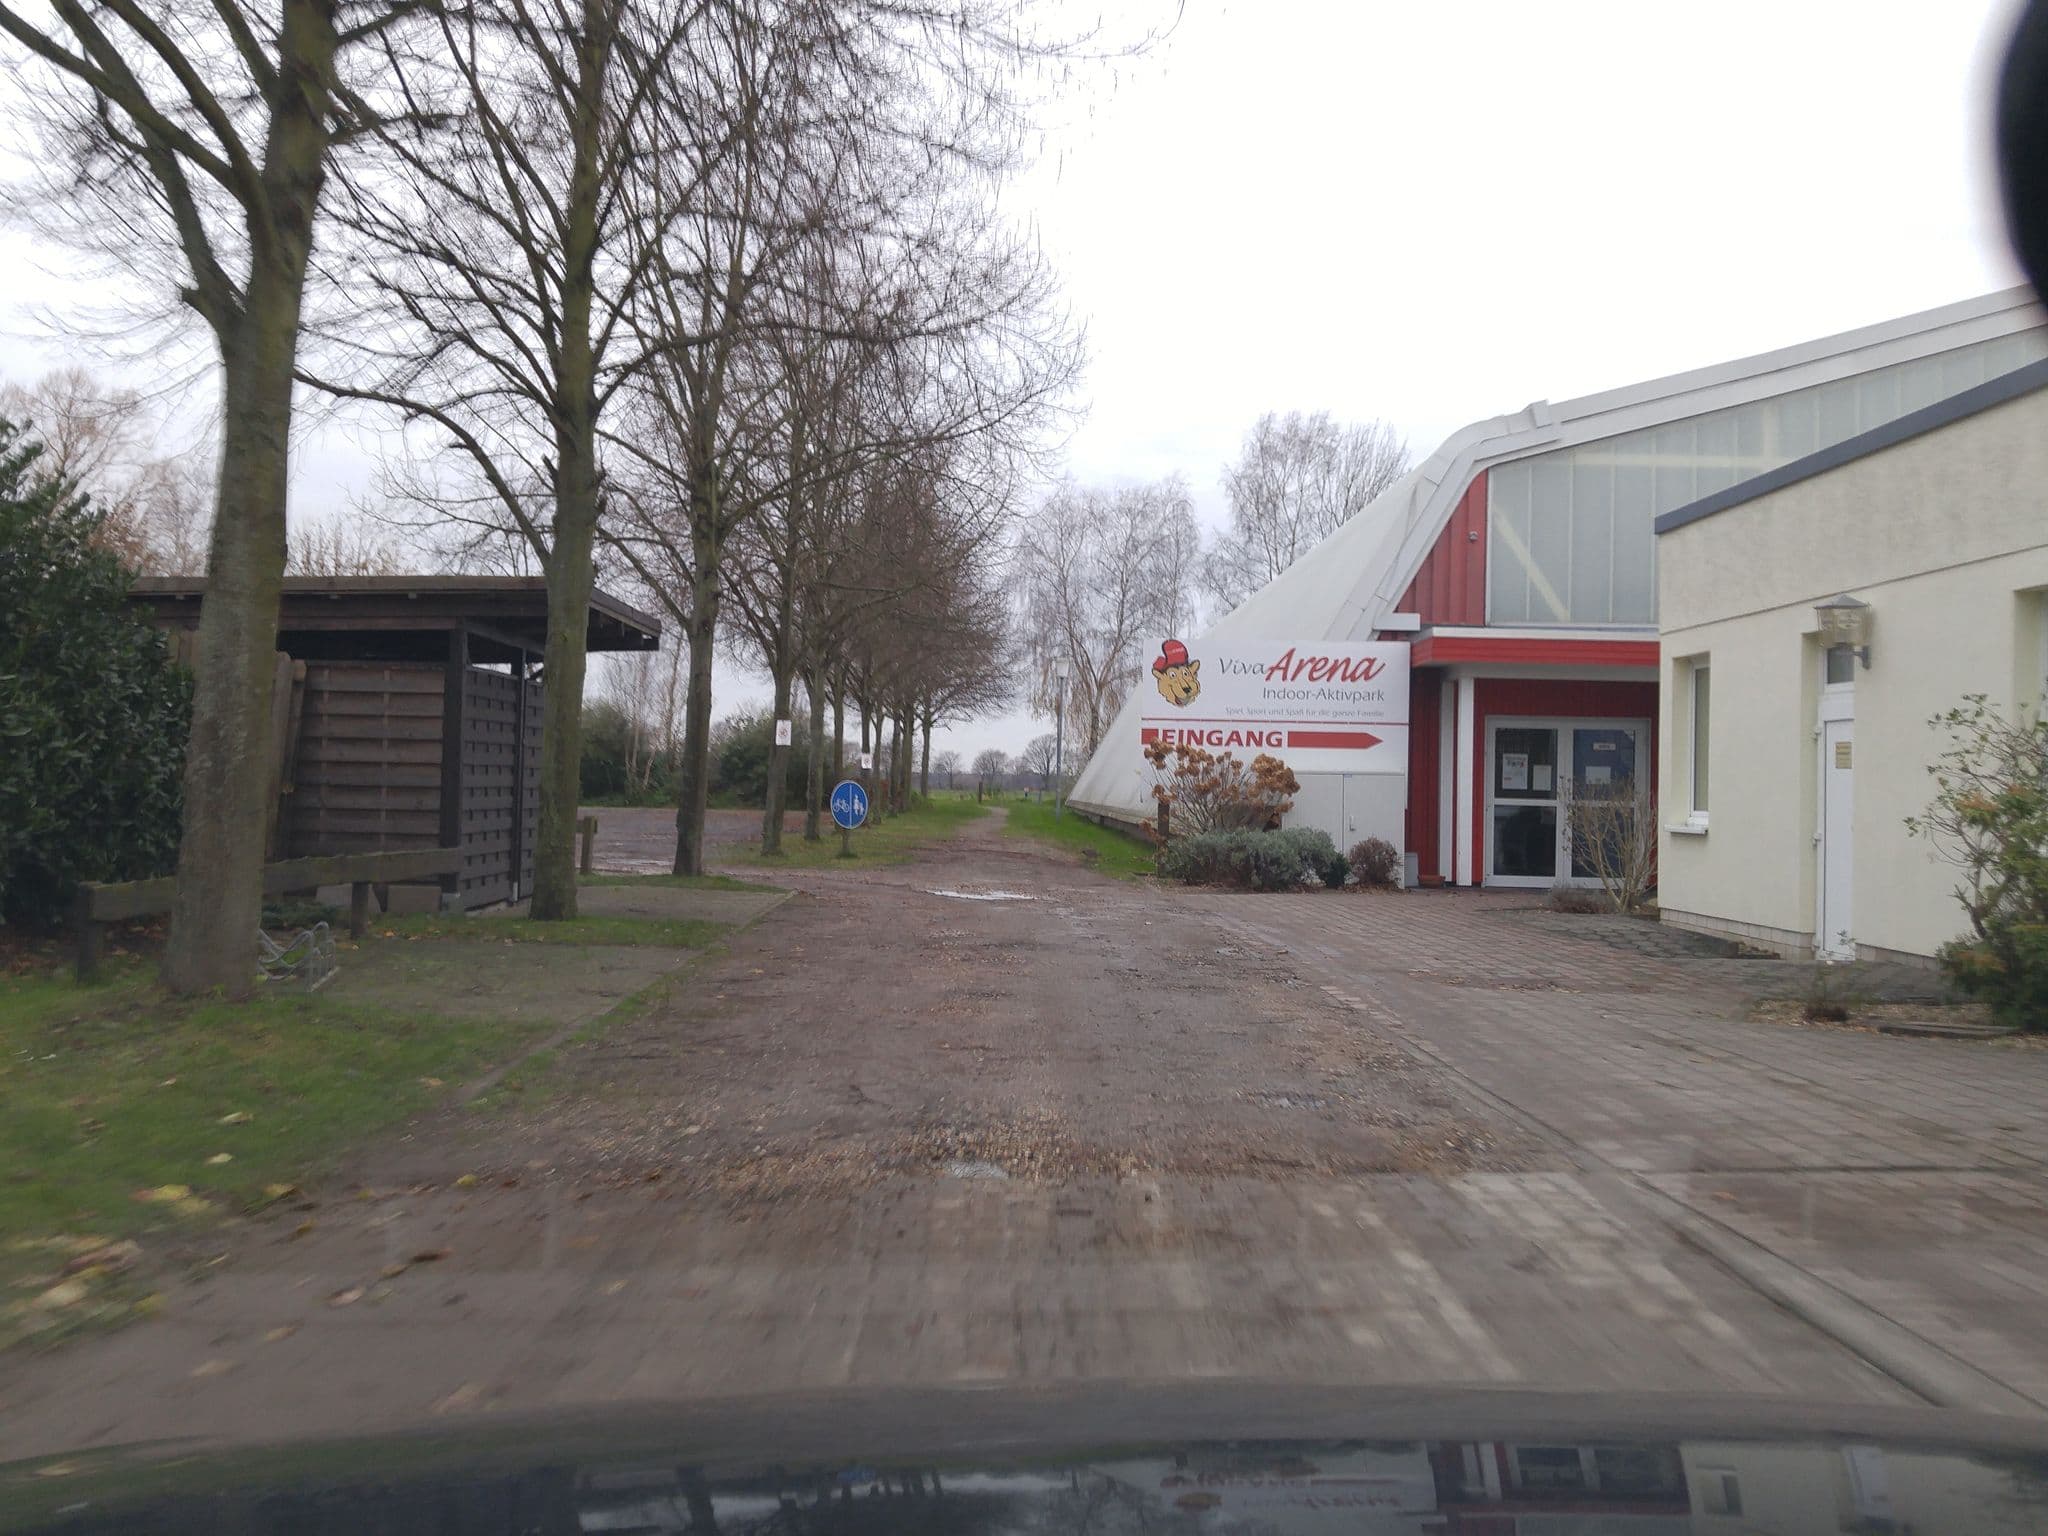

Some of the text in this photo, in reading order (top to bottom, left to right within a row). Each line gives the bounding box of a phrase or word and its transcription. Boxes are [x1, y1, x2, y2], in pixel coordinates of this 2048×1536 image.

[1218, 647, 1386, 683] Viva Arena
[1262, 687, 1384, 704] Indoor-Aktivpark
[1161, 729, 1283, 748] EINGANG
